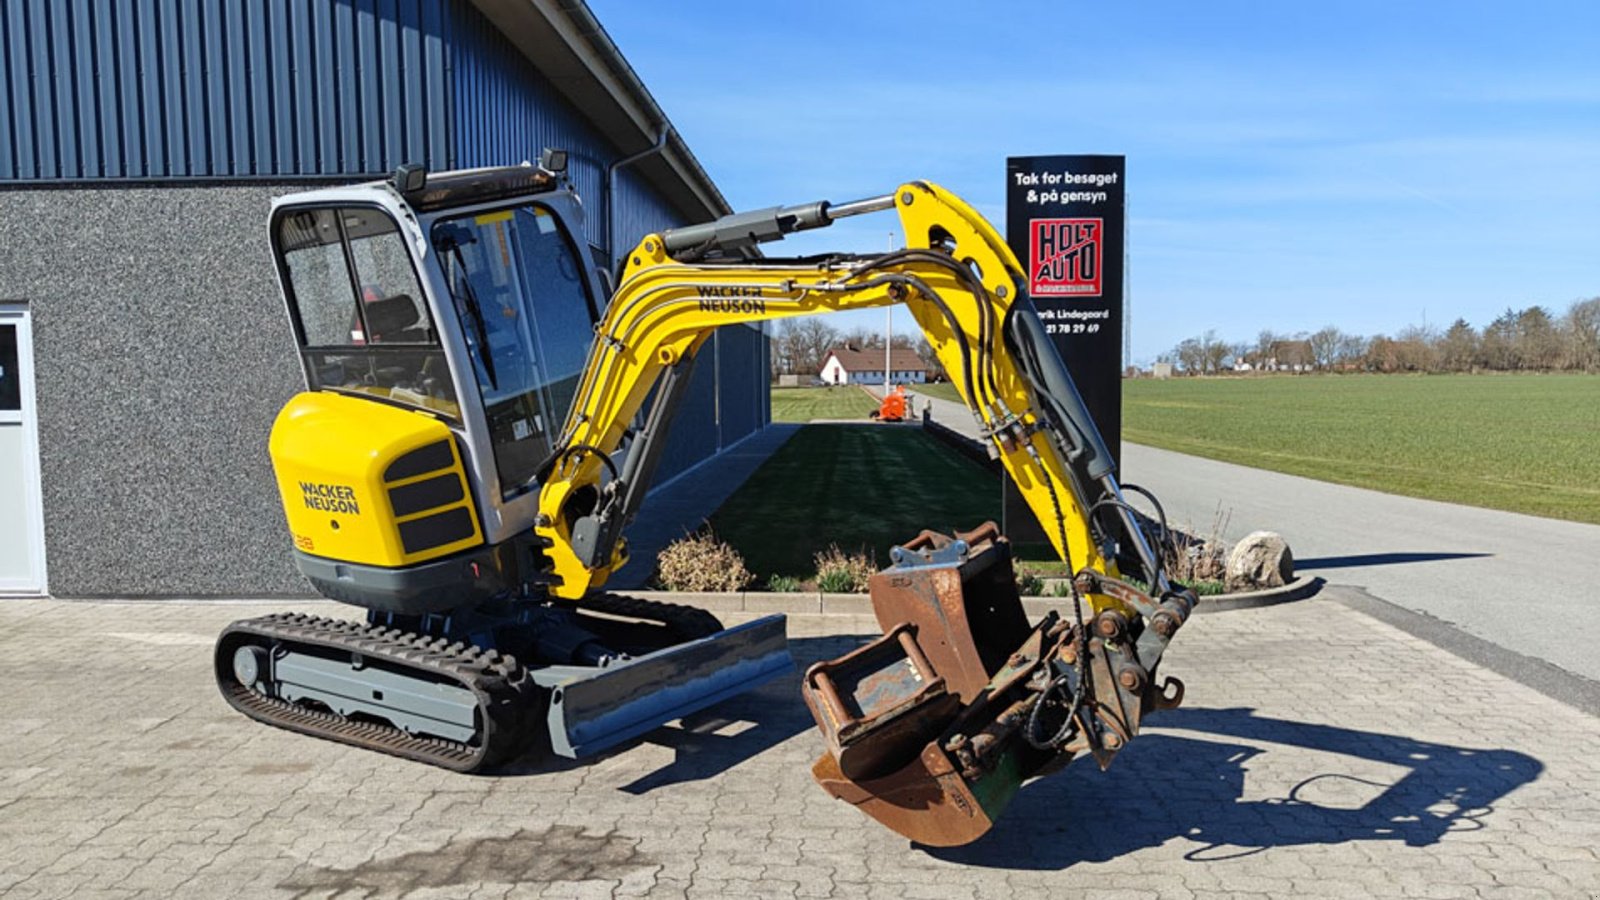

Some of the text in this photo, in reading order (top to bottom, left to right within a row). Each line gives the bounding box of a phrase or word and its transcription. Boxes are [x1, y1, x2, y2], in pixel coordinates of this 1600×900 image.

[1015, 171, 1118, 187] Tak for besøget
[1026, 188, 1107, 205] & på gensyn
[1038, 223, 1096, 263] HOLT
[1036, 240, 1096, 282] AUTO
[696, 285, 763, 297] WACKER
[699, 299, 766, 315] NEUSON
[1057, 309, 1110, 320] Lindegaard
[1046, 323, 1100, 334] 21 78 29 69
[298, 480, 356, 500] WACKER
[304, 495, 360, 515] NEUSON
